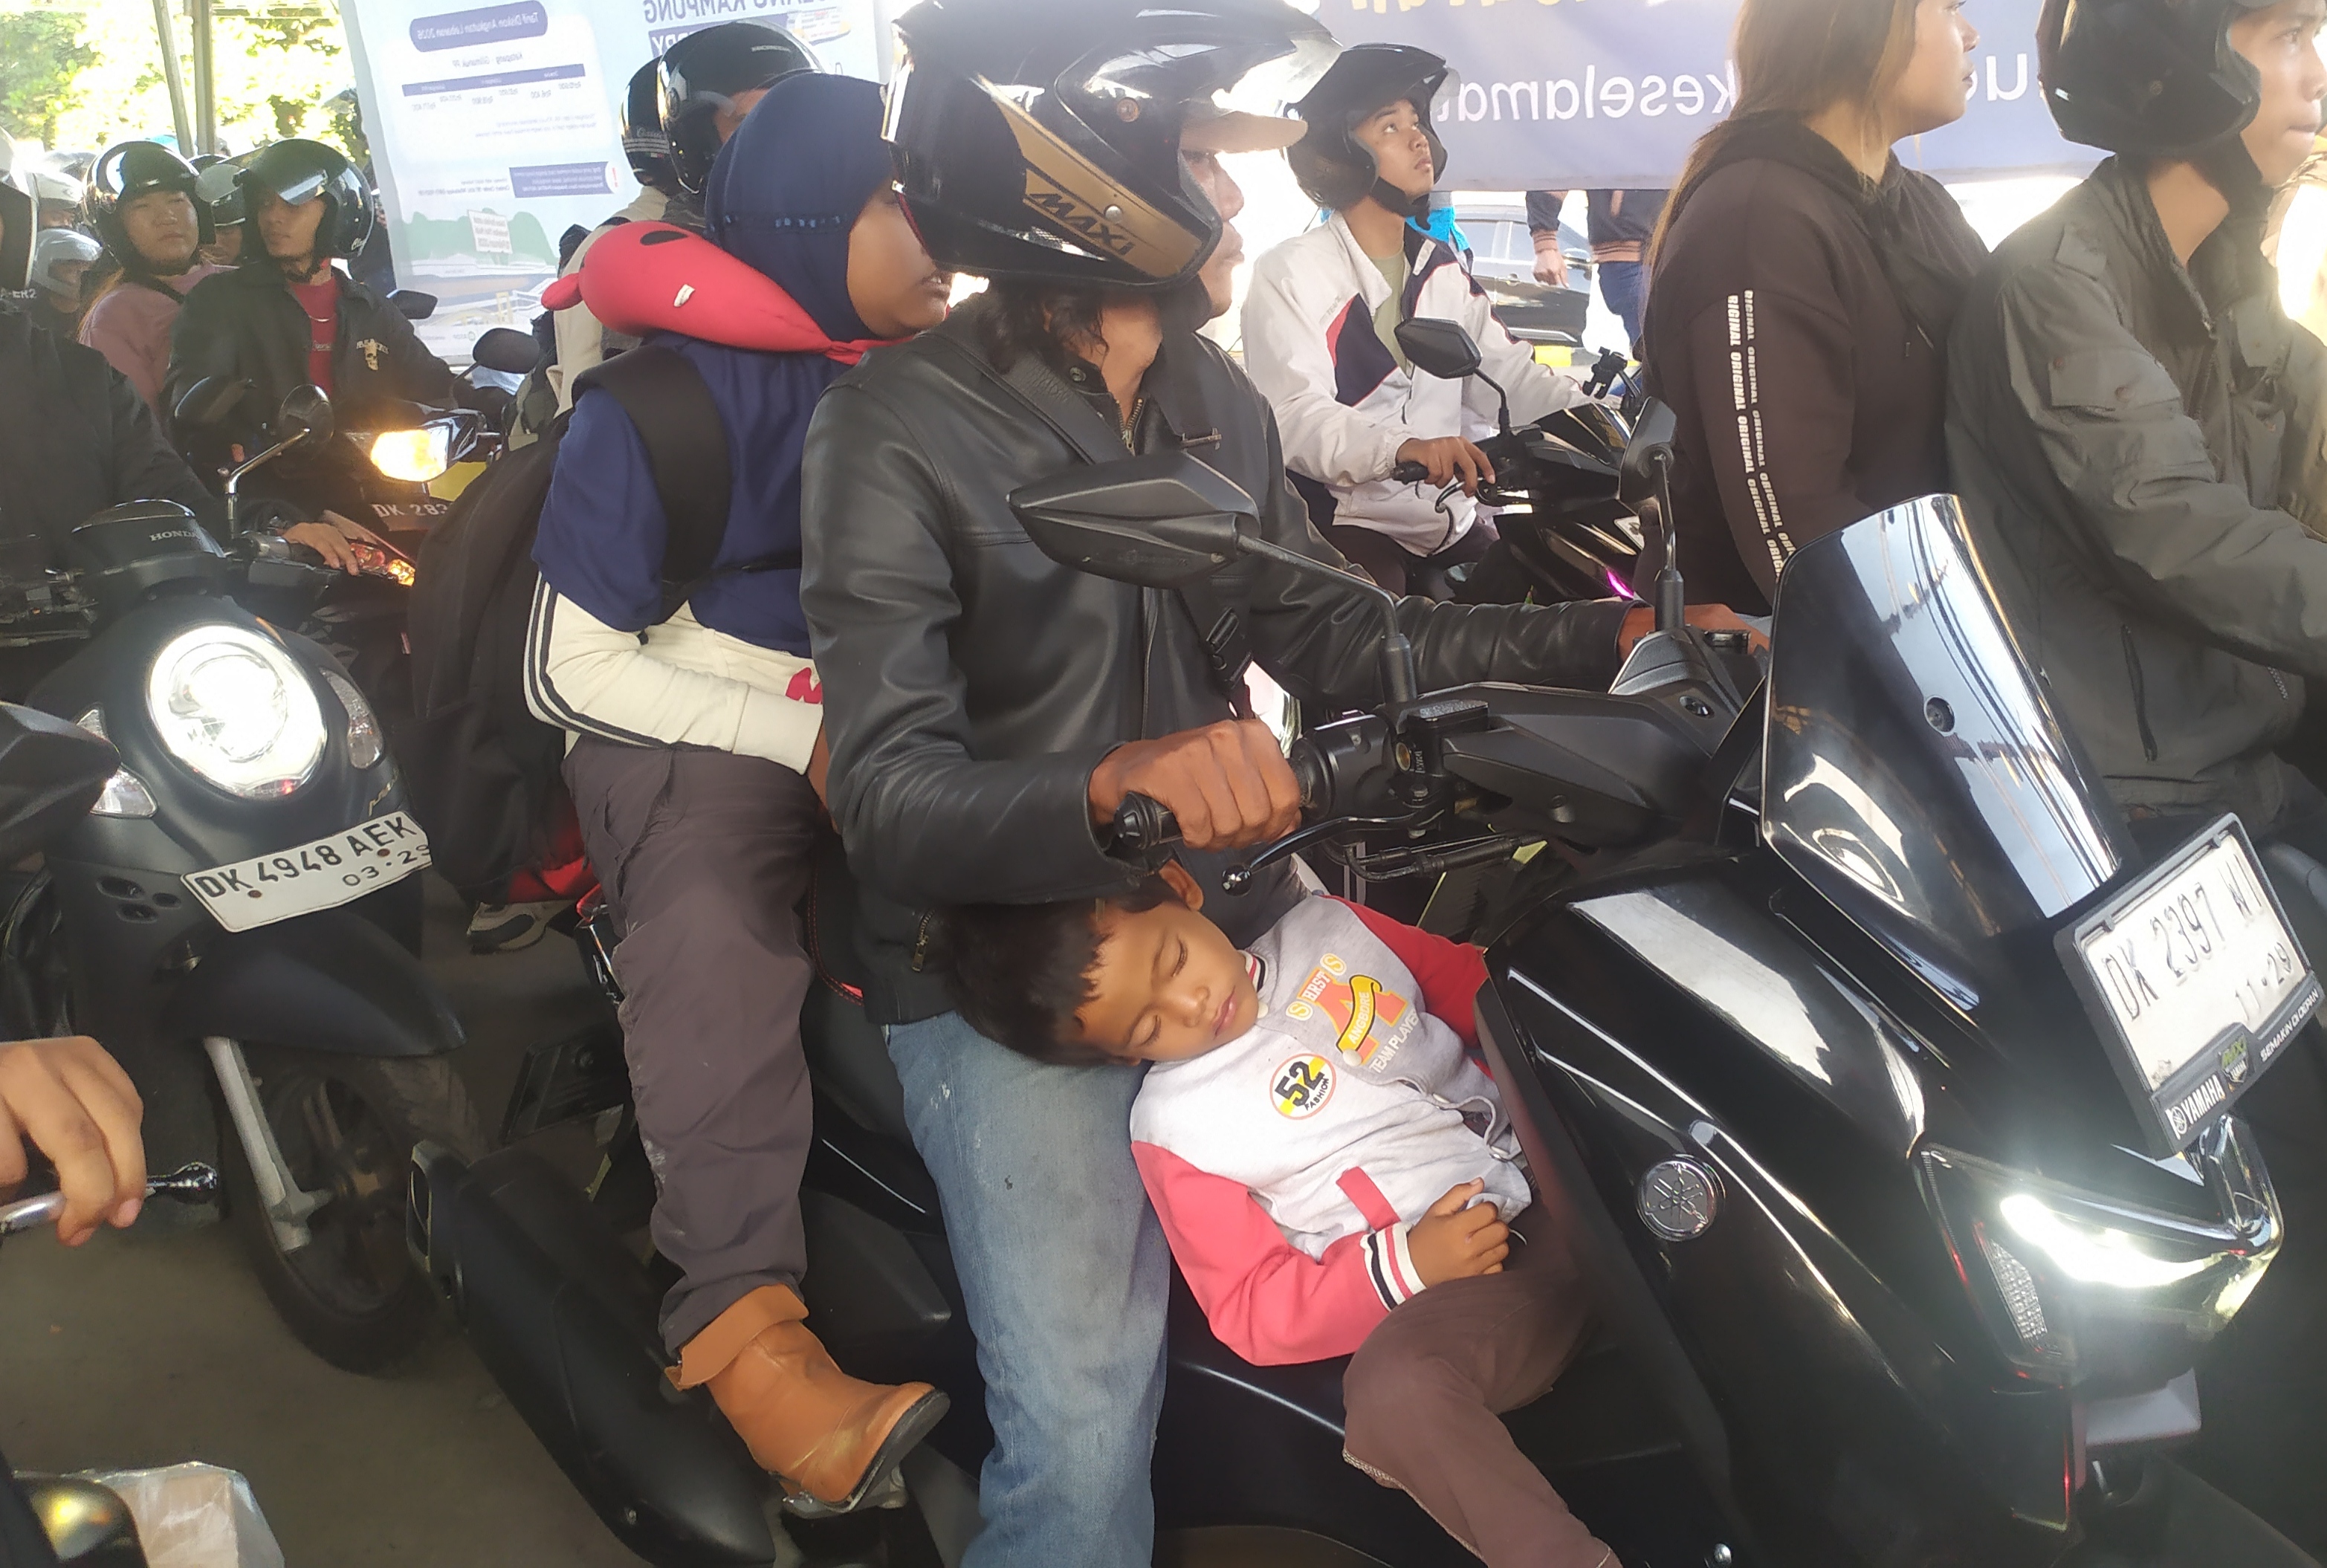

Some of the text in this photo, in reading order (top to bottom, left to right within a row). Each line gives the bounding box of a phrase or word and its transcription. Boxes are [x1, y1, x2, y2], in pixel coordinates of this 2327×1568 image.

[1029, 193, 1136, 256] MAXI
[1730, 351, 1747, 411] ORIGINAL
[1748, 346, 1758, 404] ORIGINAL
[1737, 415, 1755, 473] ORIGINAL
[1752, 410, 1765, 467] ORIGINAL
[372, 504, 405, 518] DK
[1747, 479, 1771, 534] ORIGINAL
[1759, 473, 1783, 528] ORIGINAL
[194, 816, 418, 898] DK 4948 AEK
[2103, 937, 2160, 1022] DK
[2150, 881, 2226, 979] 2397
[1275, 1060, 1325, 1107] 52
[1369, 1044, 1396, 1074] TEAM
[1304, 1078, 1330, 1110] FASHION
[2181, 1074, 2227, 1125] YAMAHA
